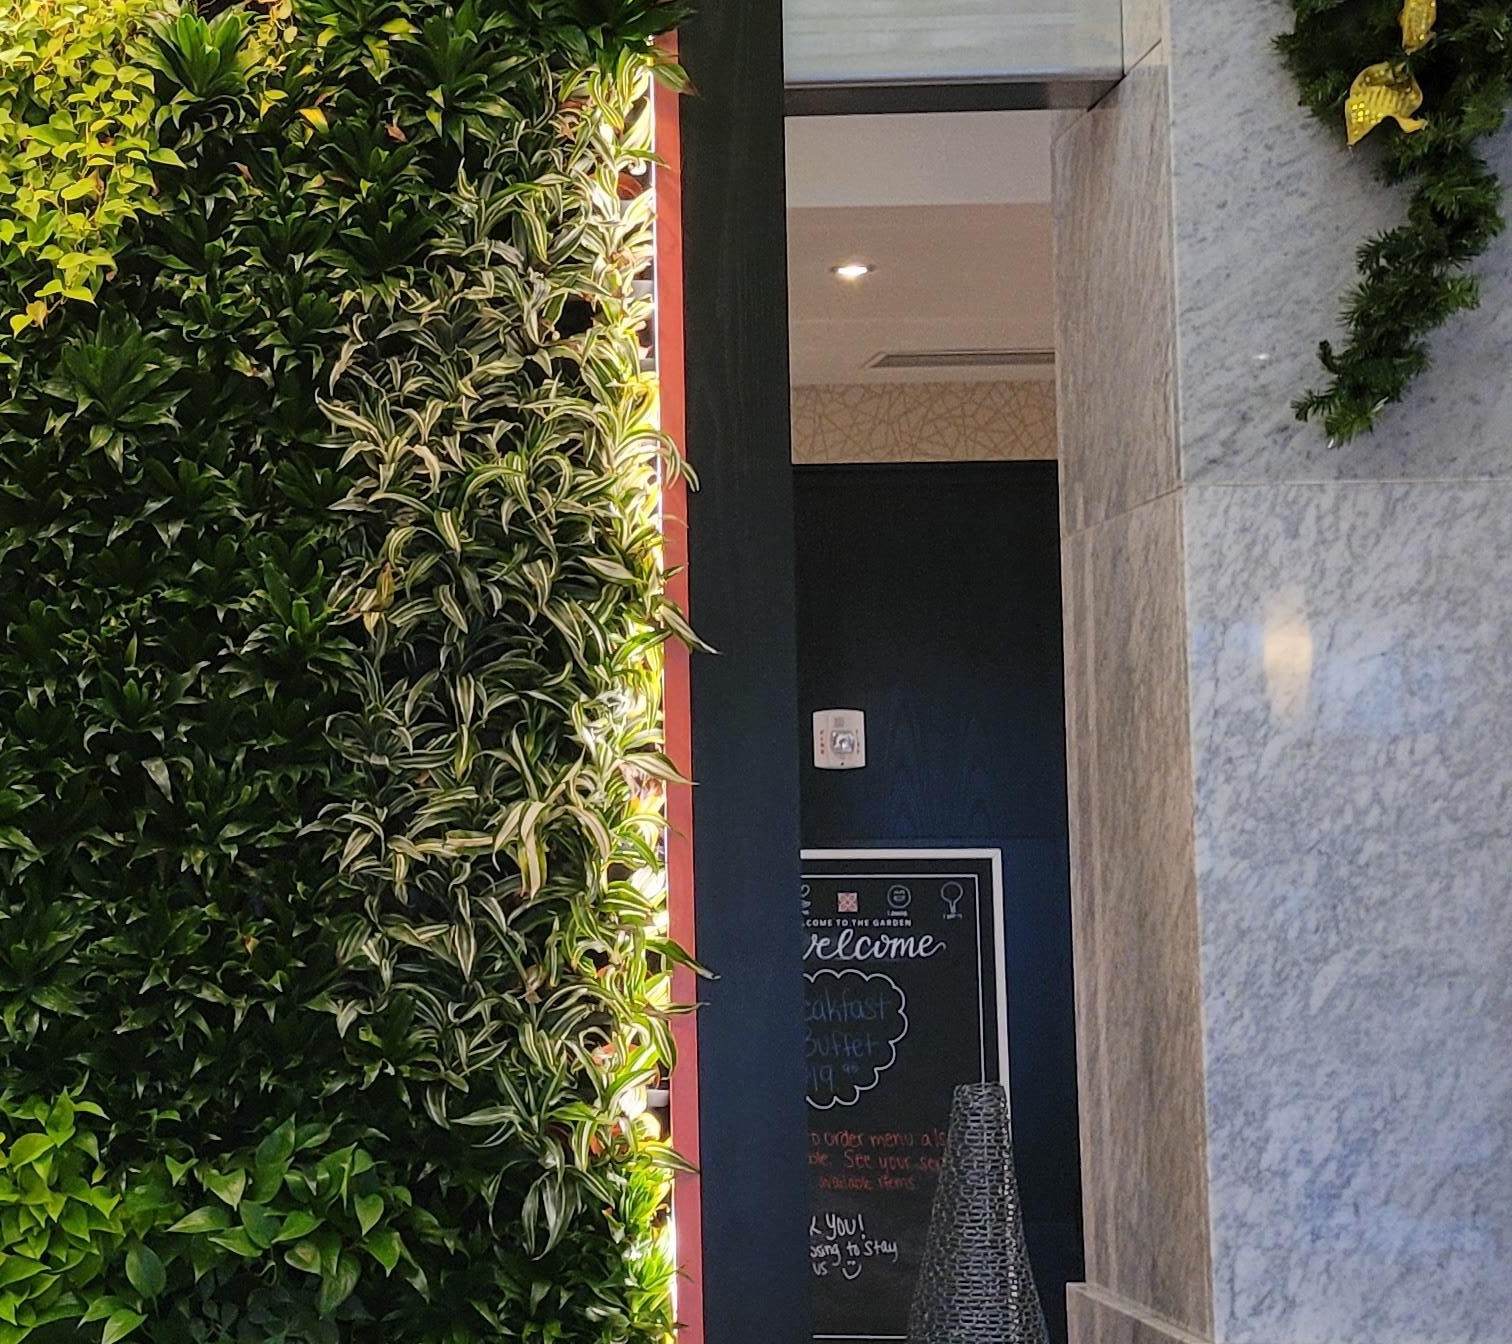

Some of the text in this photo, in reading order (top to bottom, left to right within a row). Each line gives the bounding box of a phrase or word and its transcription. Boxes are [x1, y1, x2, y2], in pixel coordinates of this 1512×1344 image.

[802, 918, 912, 927] COME TO THE GARDEN
[870, 1131, 914, 1147] menu
[843, 1148, 872, 1169] See
[878, 1154, 912, 1174] your
[846, 1240, 861, 1257] to
